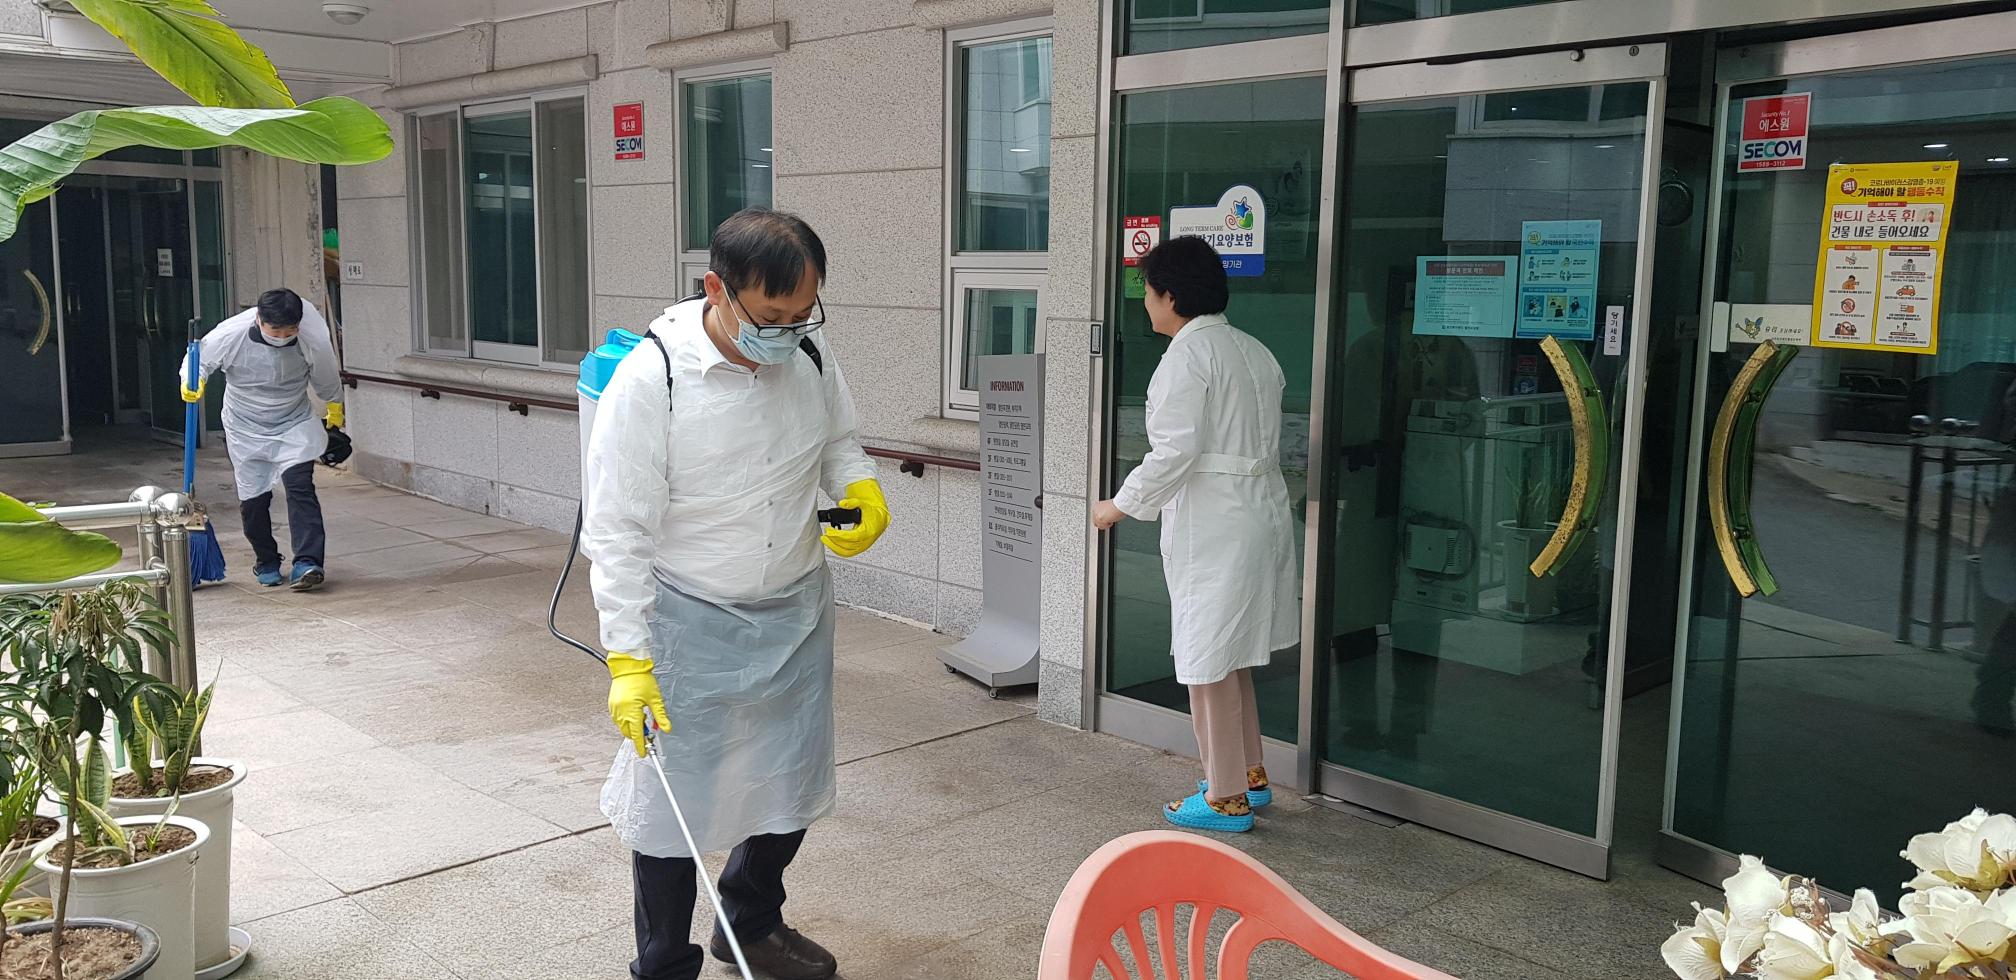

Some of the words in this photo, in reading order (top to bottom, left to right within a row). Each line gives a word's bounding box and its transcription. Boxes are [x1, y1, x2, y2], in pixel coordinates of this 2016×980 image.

[1759, 117, 1790, 132] 에스원
[616, 138, 642, 152] SECOM
[1744, 139, 1802, 160] SECOM
[1858, 187, 1894, 198] 기억해야
[1896, 187, 1907, 198] 할
[1833, 210, 1863, 223] 반드시
[1867, 210, 1897, 223] 손소독
[1901, 209, 1916, 223] 후!
[1831, 225, 1851, 239] 건물
[1854, 226, 1874, 238] 내로
[1878, 225, 1930, 239] 들어오세요
[1609, 312, 1619, 343] 당기세요
[990, 381, 1025, 392] INFORMATION
